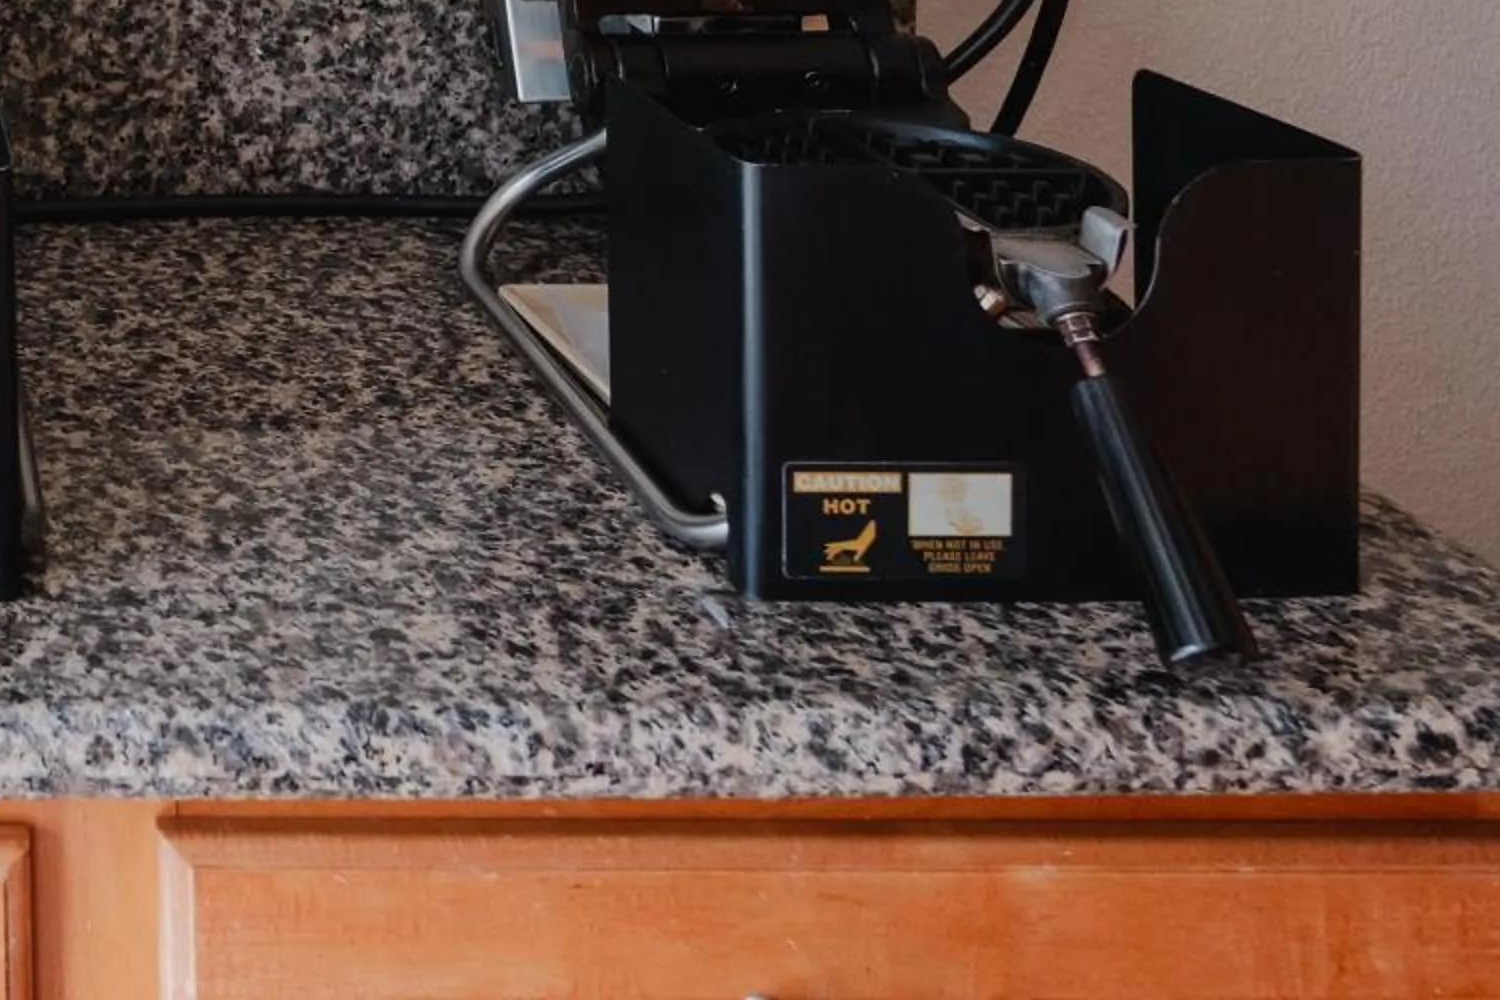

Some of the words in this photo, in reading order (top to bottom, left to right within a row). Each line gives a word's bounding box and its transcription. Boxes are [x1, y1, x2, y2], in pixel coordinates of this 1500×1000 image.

[797, 473, 901, 491] CAUTION
[822, 498, 872, 515] HOT
[923, 551, 961, 562] PLEASE
[964, 551, 996, 562] LEAVE
[963, 562, 992, 574] OPEN
